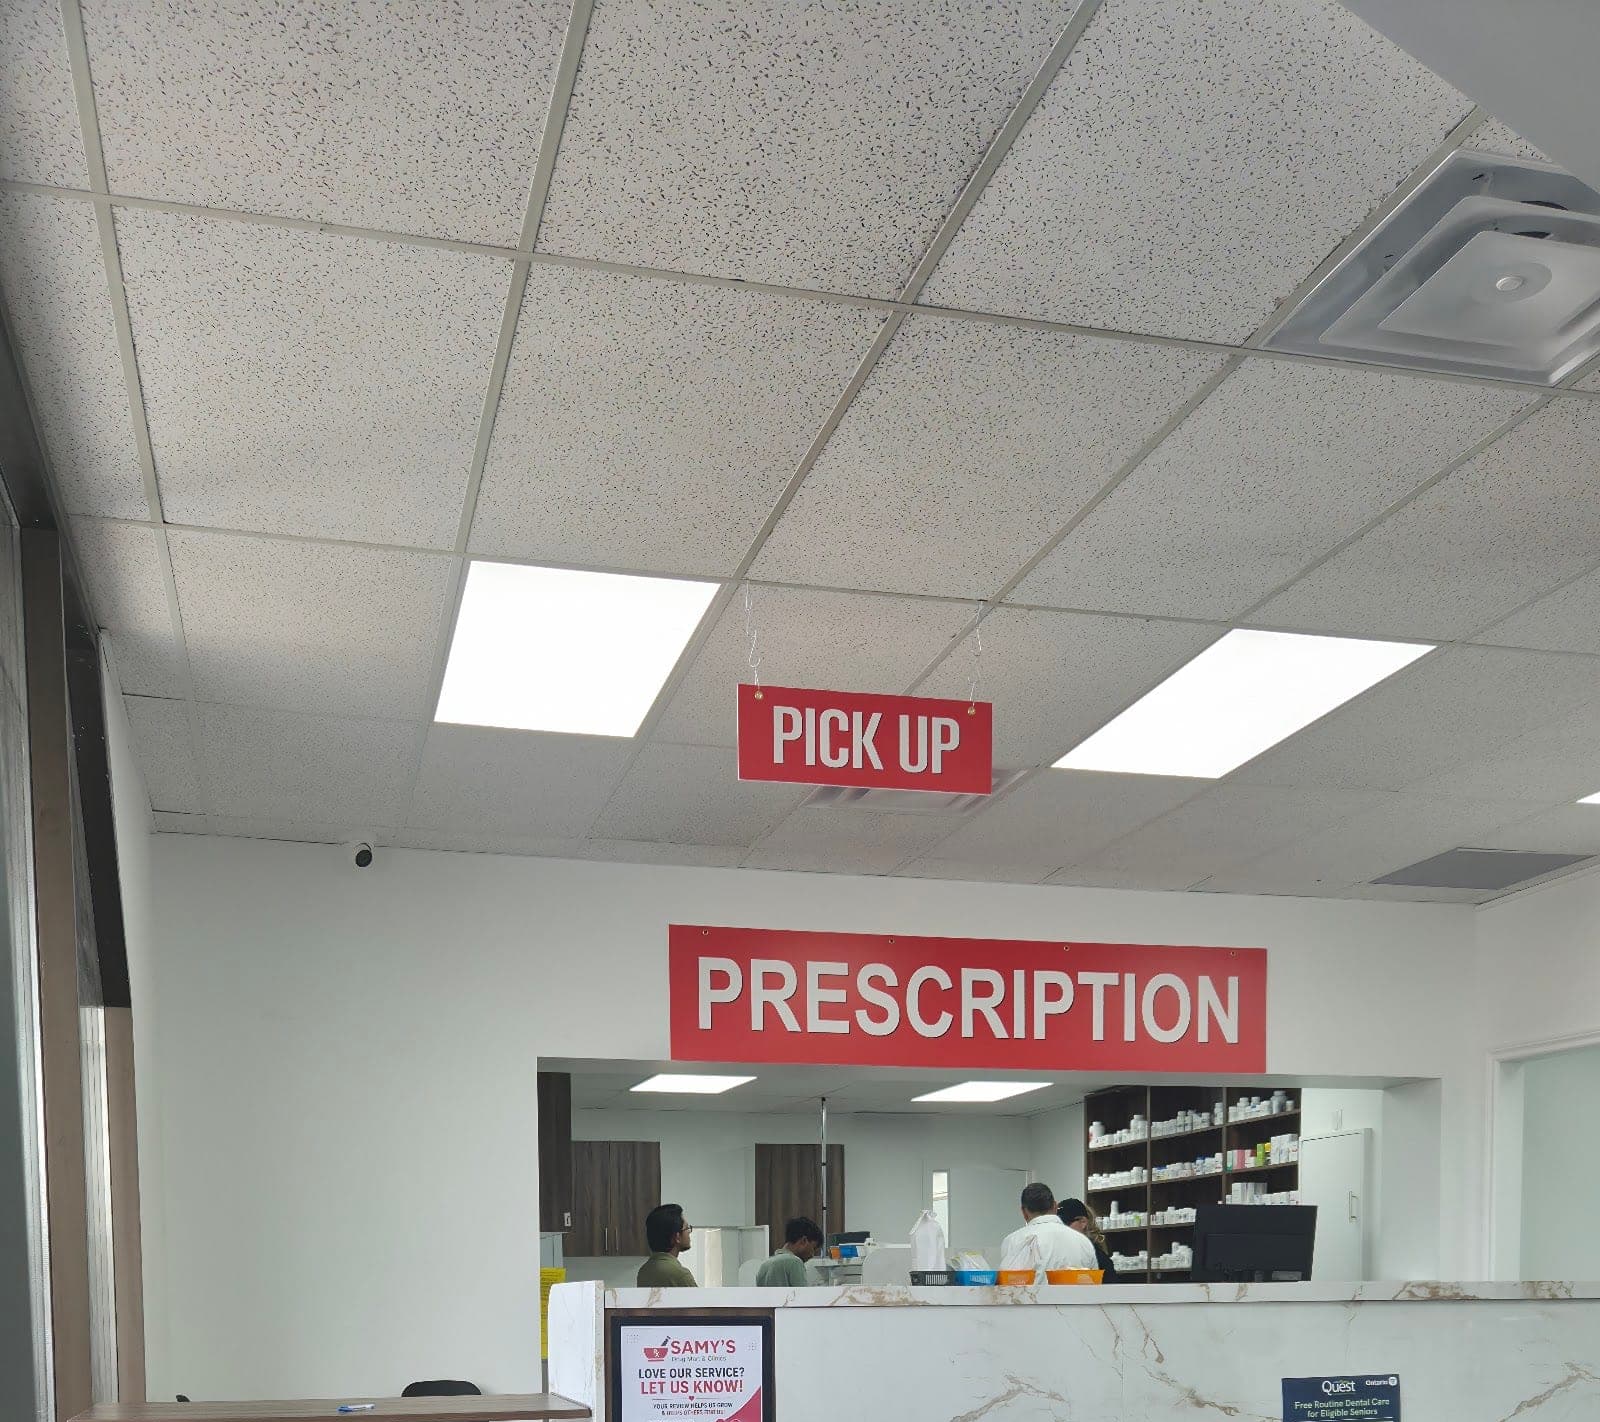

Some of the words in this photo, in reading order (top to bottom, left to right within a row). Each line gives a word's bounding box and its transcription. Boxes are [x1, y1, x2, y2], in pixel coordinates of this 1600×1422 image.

[772, 705, 885, 771] PICK
[898, 714, 961, 774] UP
[697, 955, 1240, 1045] PRESCRIPTION
[670, 1339, 736, 1354] SAMY'S
[638, 1368, 666, 1379] LOVE
[669, 1368, 692, 1379] OUR
[695, 1367, 745, 1378] SERVICE?
[640, 1381, 666, 1395] LET
[670, 1380, 689, 1394] US
[693, 1379, 743, 1393] KNOW!
[1321, 1380, 1357, 1396] Quest
[1294, 1401, 1313, 1410] Free
[1314, 1399, 1344, 1409] Routine
[1345, 1398, 1370, 1407] Dental
[1371, 1398, 1390, 1406] Care
[1320, 1409, 1349, 1419] Eligible
[1349, 1408, 1378, 1416] Seniors
